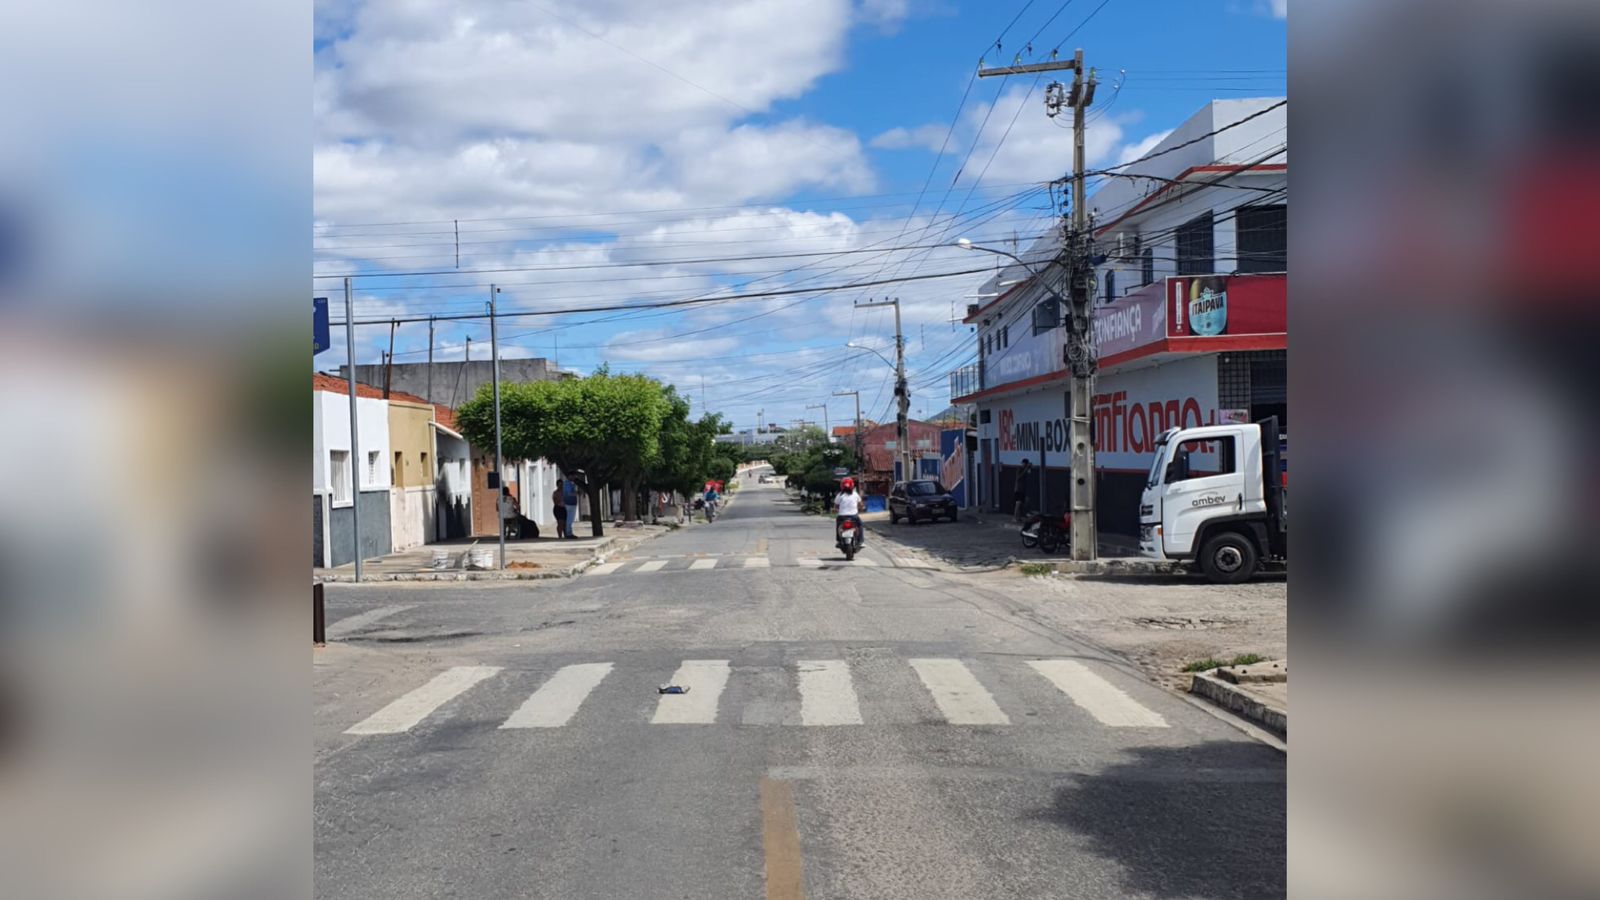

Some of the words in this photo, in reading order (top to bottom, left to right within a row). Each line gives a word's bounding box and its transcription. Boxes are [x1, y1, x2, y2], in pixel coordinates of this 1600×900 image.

[1192, 296, 1224, 316] ITAIPAVA
[1016, 421, 1040, 452] MINI
[1045, 419, 1071, 453] BOX
